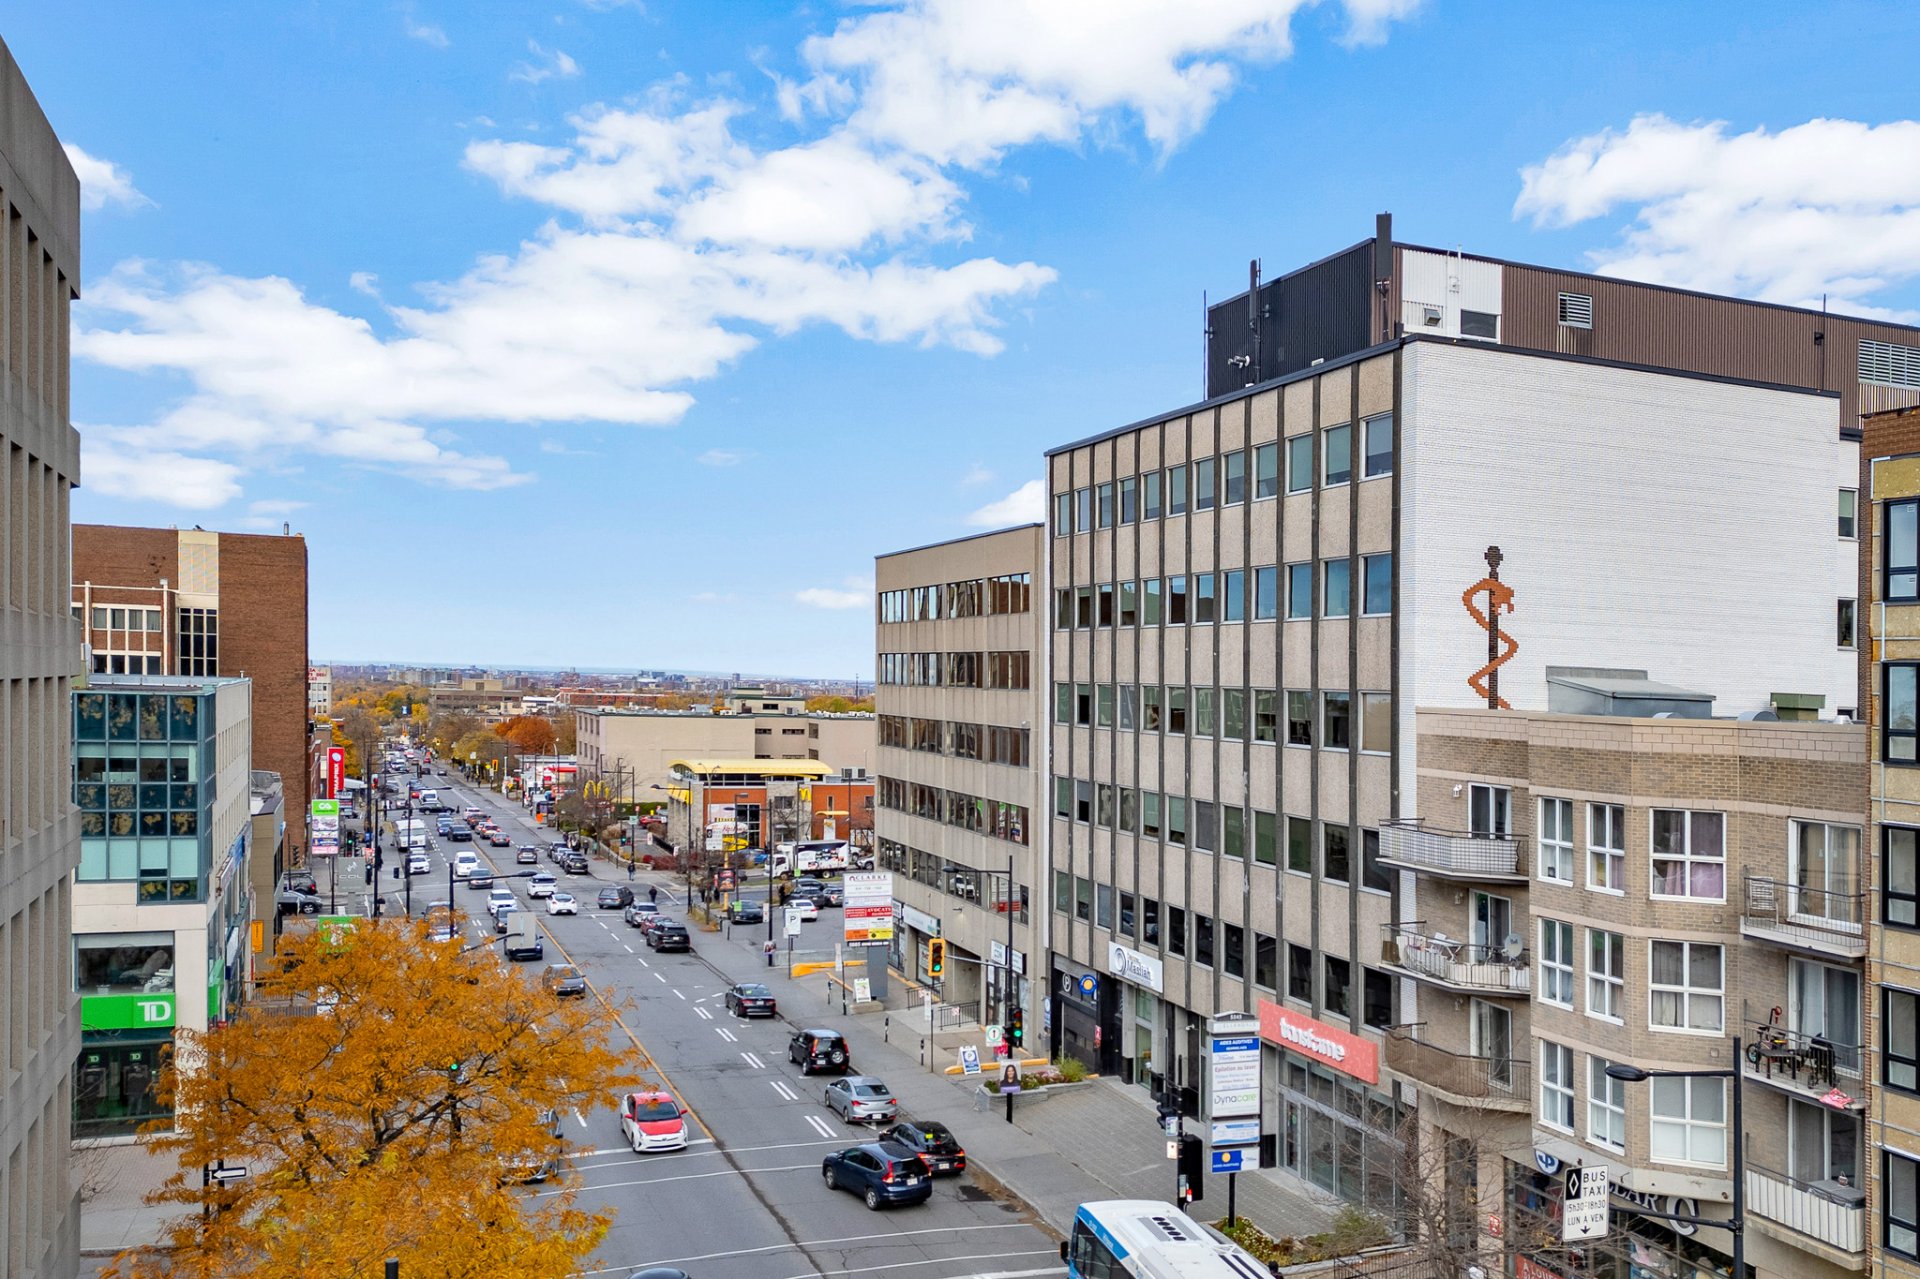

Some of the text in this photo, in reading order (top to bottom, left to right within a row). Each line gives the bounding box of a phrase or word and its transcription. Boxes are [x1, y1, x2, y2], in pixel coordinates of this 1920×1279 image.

[137, 1001, 172, 1022] TD
[89, 1055, 99, 1063] TD
[1214, 1094, 1256, 1105] Dynacare
[1583, 1170, 1606, 1183] BUS
[1583, 1184, 1606, 1197] TAXI
[1567, 1216, 1580, 1226] LUN
[1591, 1213, 1604, 1223] VEN
